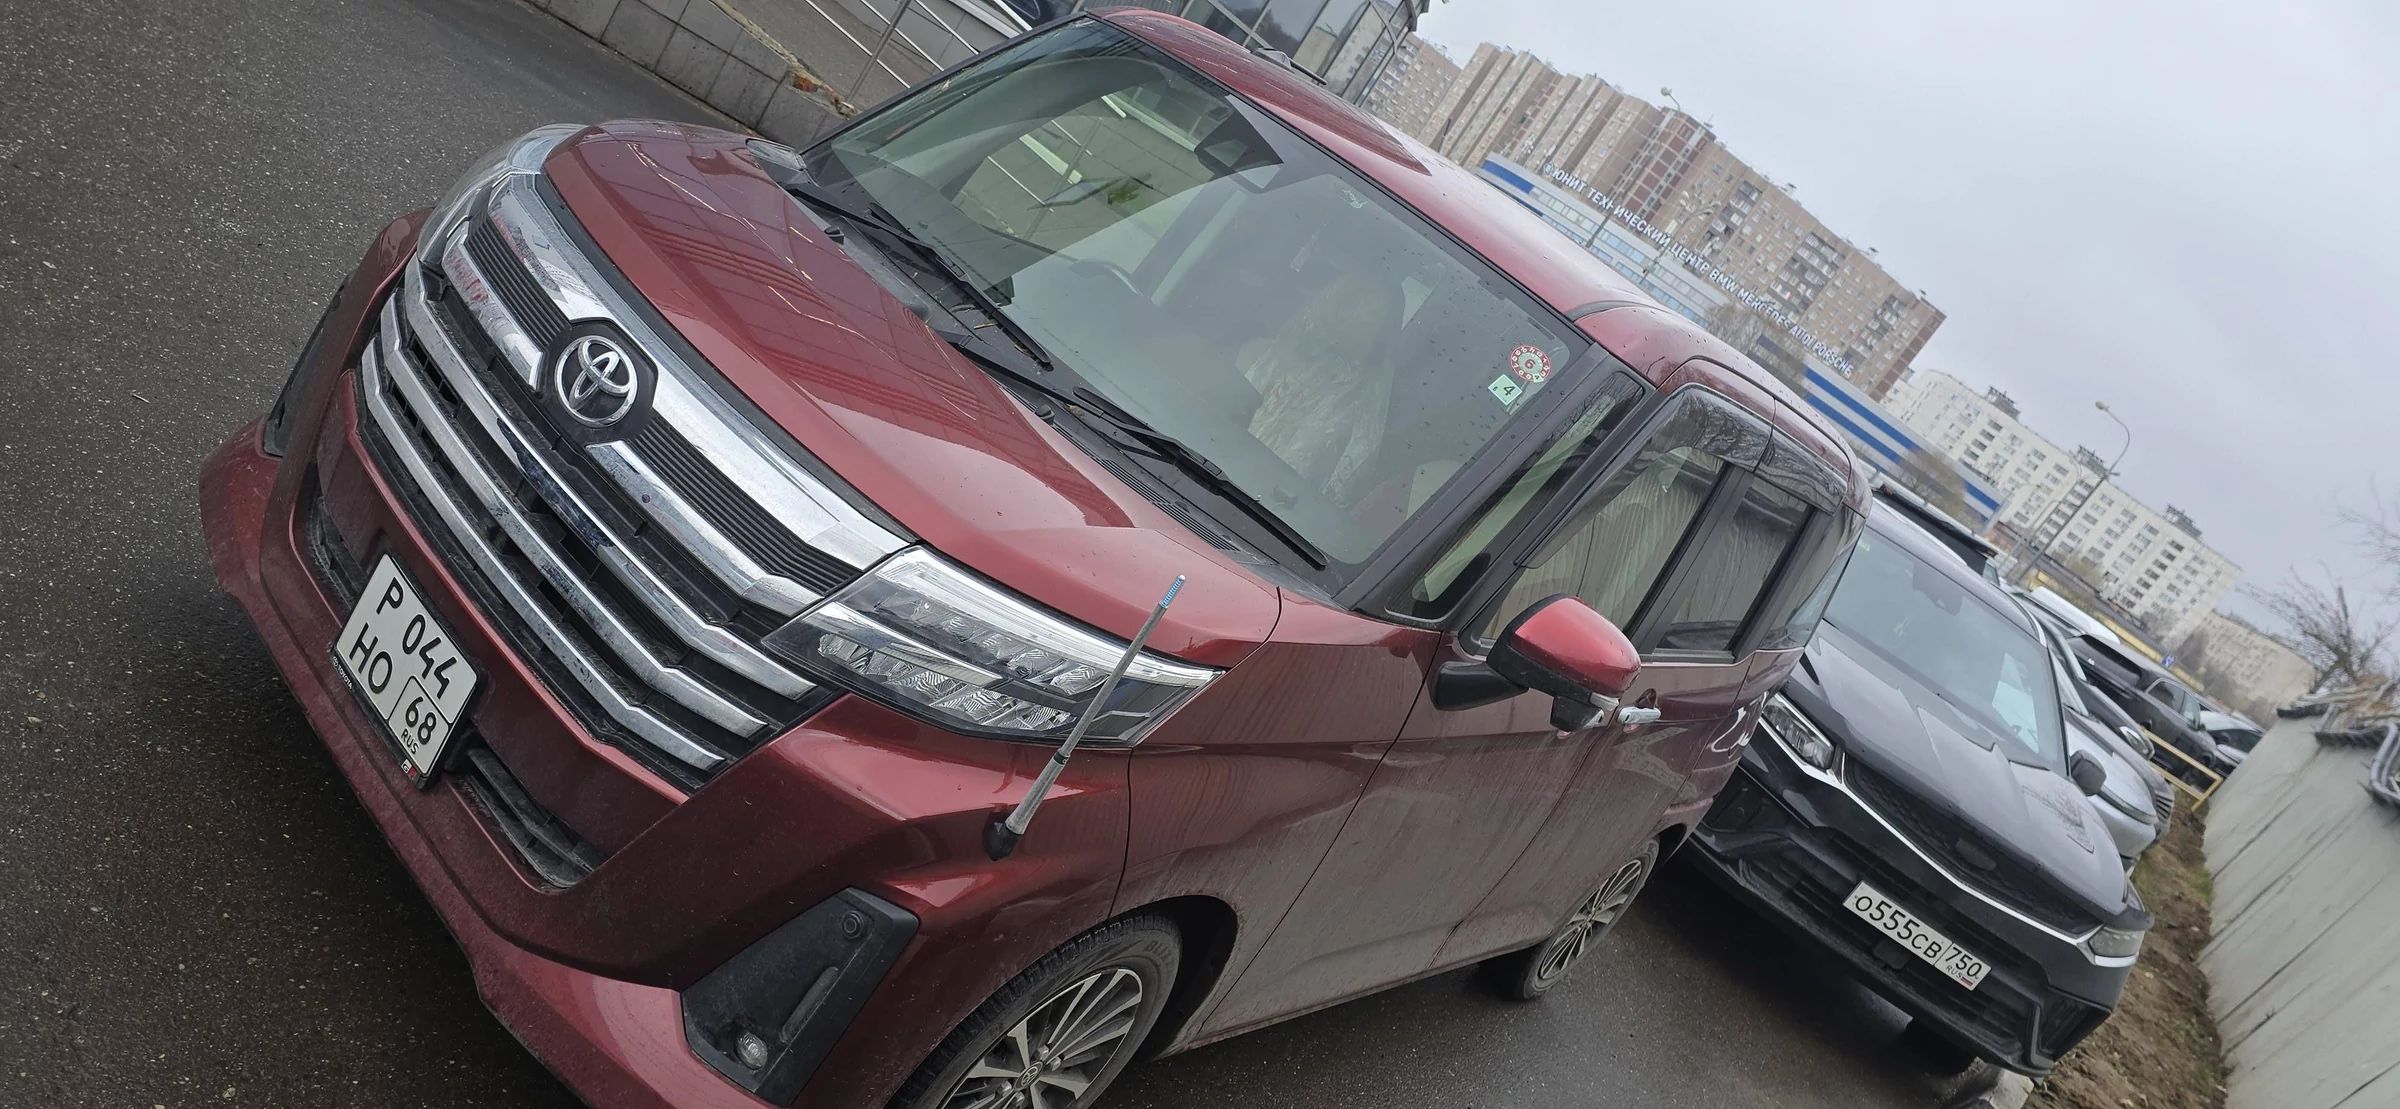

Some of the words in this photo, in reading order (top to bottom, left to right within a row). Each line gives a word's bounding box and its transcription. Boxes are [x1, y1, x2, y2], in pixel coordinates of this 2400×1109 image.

[1552, 168, 1587, 194] ЮНИТ
[1672, 243, 1710, 273] ЦЕНТР
[1709, 268, 1739, 292] BMW
[1788, 325, 1814, 347] AUDI
[1812, 340, 1854, 378] PORSCHE
[1503, 386, 1516, 396] 4
[376, 576, 404, 615] Р
[402, 614, 457, 700] 044
[349, 622, 393, 695] НО
[338, 664, 353, 690] TOYOTA
[405, 696, 437, 745] 68
[401, 728, 419, 755] RUS
[1945, 946, 1982, 978] 750
[1945, 965, 1962, 979] RUS
